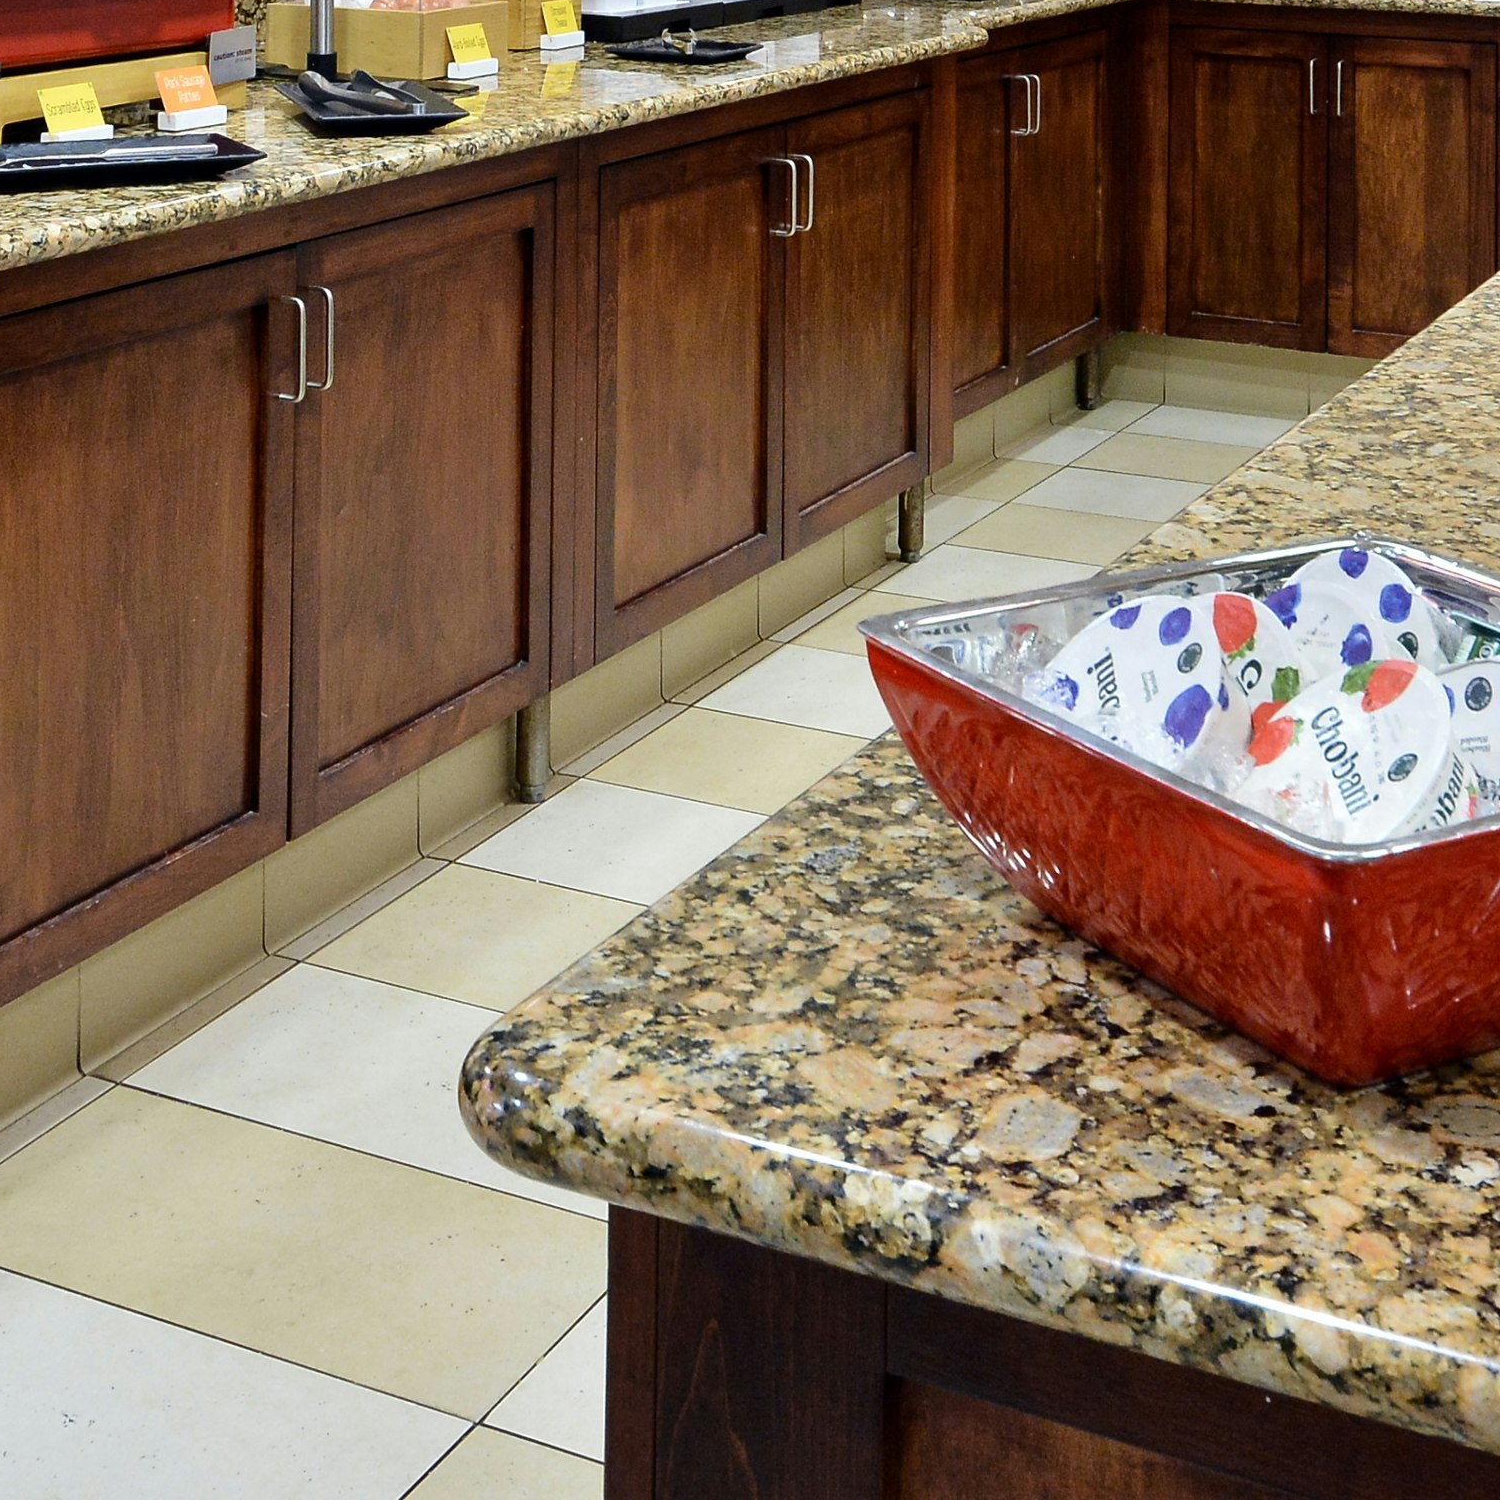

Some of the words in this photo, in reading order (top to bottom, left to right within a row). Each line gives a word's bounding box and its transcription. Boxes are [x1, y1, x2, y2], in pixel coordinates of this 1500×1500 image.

[46, 99, 80, 118] Scrambled
[80, 97, 98, 116] Eggs
[1311, 706, 1380, 816] Chobani
